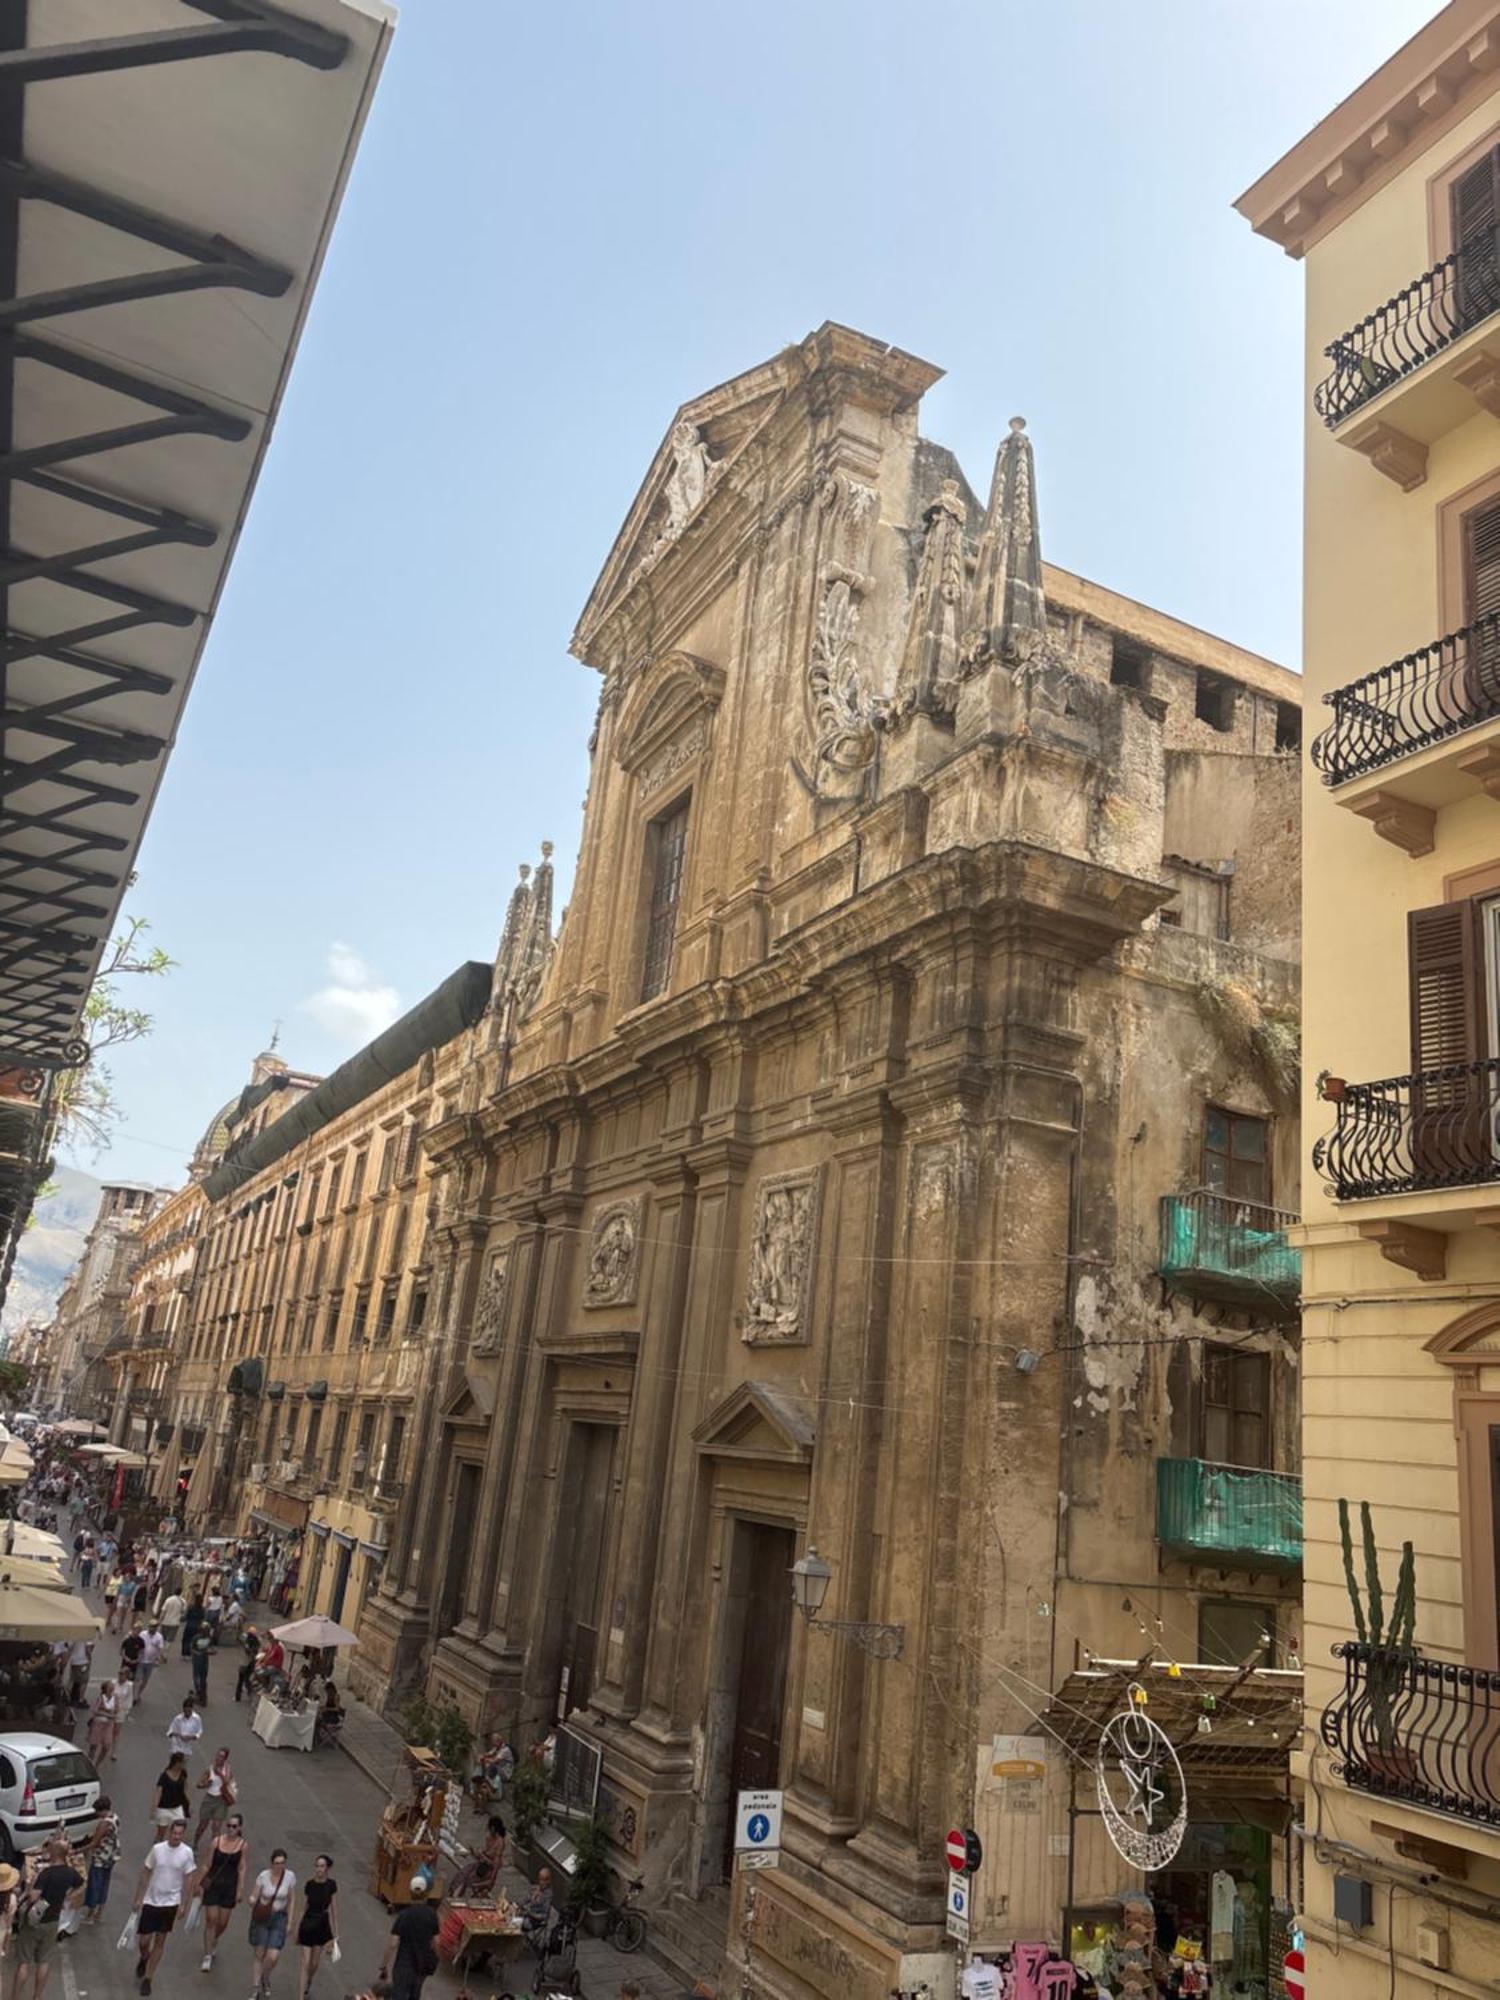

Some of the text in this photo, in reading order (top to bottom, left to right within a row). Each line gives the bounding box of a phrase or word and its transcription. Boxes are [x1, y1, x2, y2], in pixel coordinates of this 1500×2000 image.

[743, 1802, 777, 1811] pedonale
[1027, 1959, 1036, 1978] 7
[1047, 1980, 1068, 2000] 10
